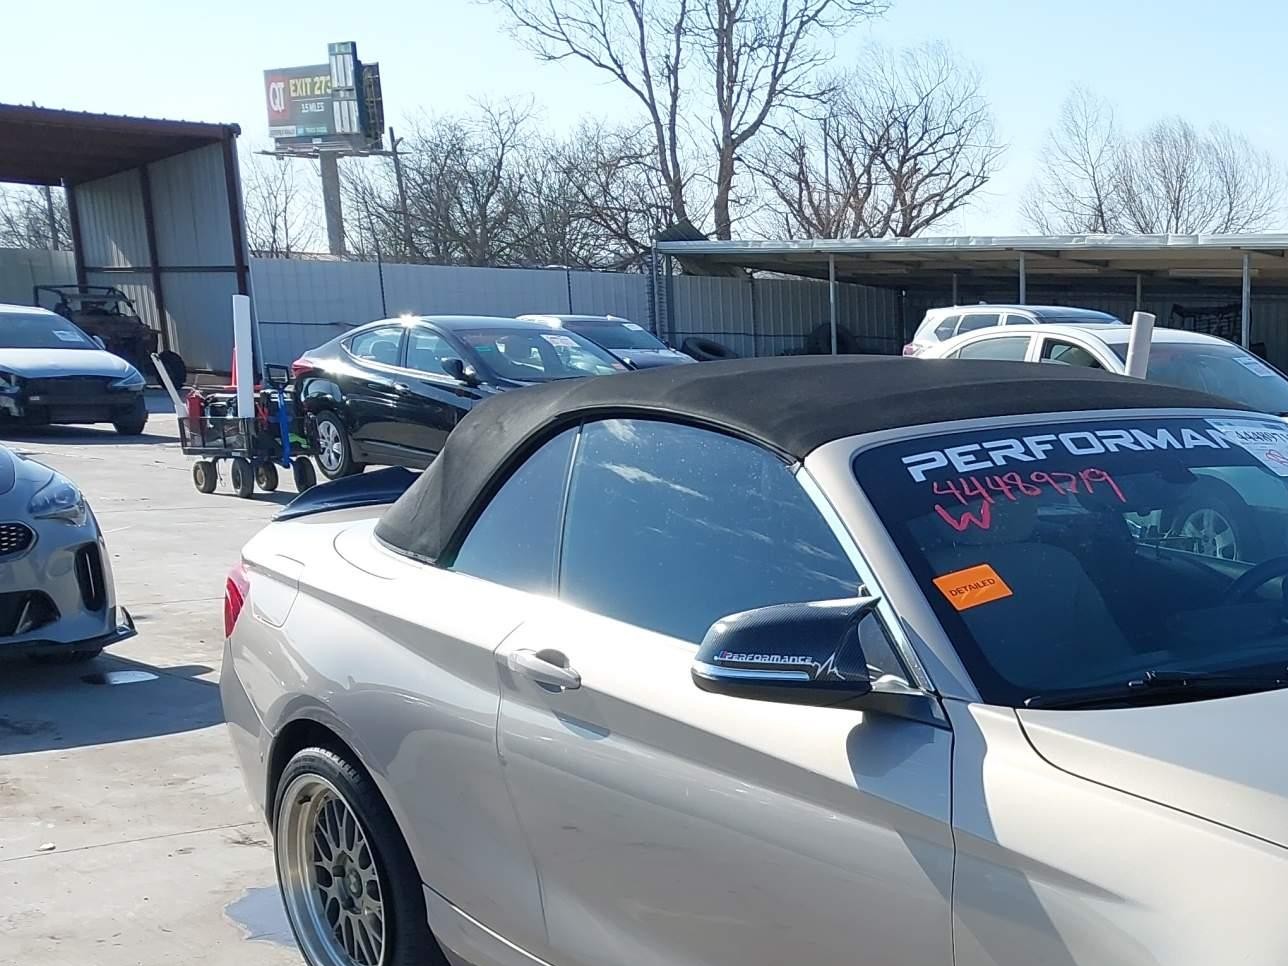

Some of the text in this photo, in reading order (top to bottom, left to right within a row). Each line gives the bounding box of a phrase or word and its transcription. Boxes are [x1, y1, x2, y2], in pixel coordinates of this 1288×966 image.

[269, 82, 285, 112] QT
[289, 78, 311, 97] EXIT
[932, 468, 1127, 506] 44489719
[934, 499, 991, 532] W
[948, 578, 996, 597] DETAILED
